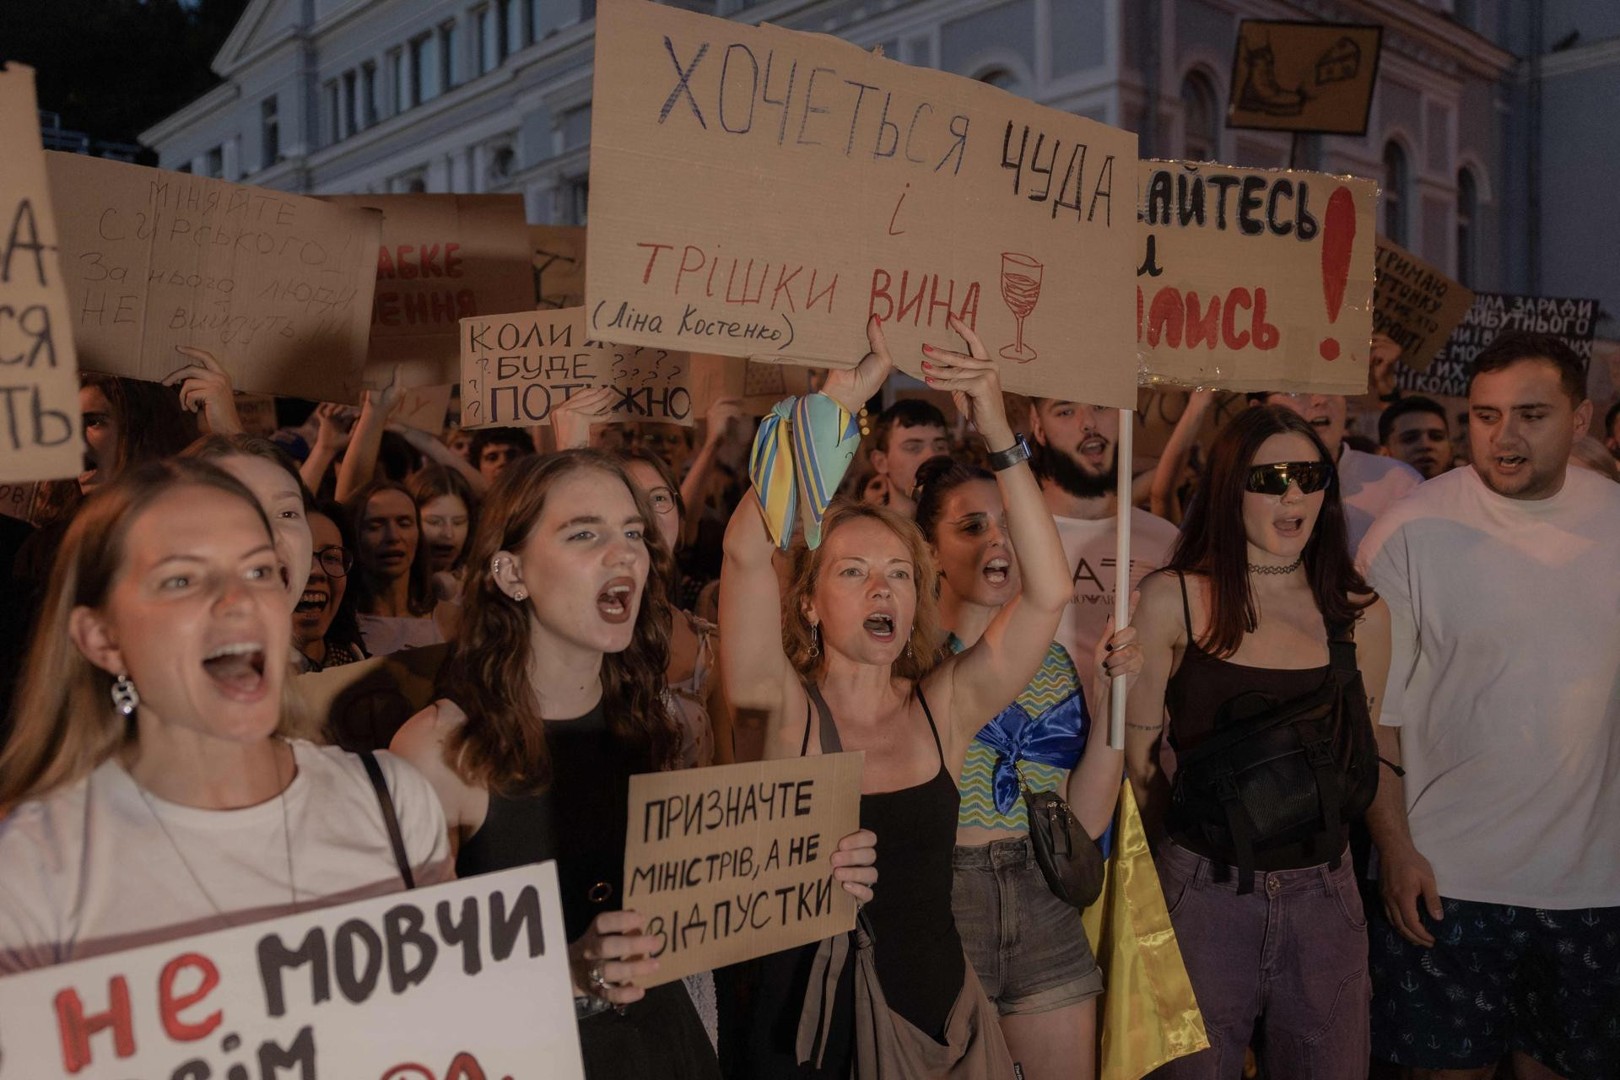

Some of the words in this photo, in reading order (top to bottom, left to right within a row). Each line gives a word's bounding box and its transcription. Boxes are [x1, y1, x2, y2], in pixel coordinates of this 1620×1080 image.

[657, 35, 971, 177] ХОЧЕТЬСЯ
[999, 119, 1117, 228] ЧУДА
[150, 181, 297, 226] МІНЯЙТЕ
[1137, 165, 1319, 241] АЙТЕСЬ
[80, 288, 139, 327] НЕ
[372, 287, 478, 327] ЕННЯ
[636, 243, 840, 314] ТРІШКИ
[868, 267, 981, 334] ВИНА
[1512, 297, 1593, 319] ЗАРАДИ
[470, 322, 573, 353] КОЛИ
[676, 303, 794, 350] Костенко)
[1137, 285, 1280, 351] ЛИСЬ
[497, 353, 597, 381] БУДЕ
[490, 383, 692, 423] ПОТЖНО
[643, 779, 814, 844] ПРИЗНАЧТЕ
[628, 846, 761, 898] МІНІСТРІВ,
[764, 837, 780, 873] А
[788, 832, 821, 868] НЕ
[644, 874, 833, 959] ВІДПУСТКИ
[254, 884, 547, 1019] МОВЧИ
